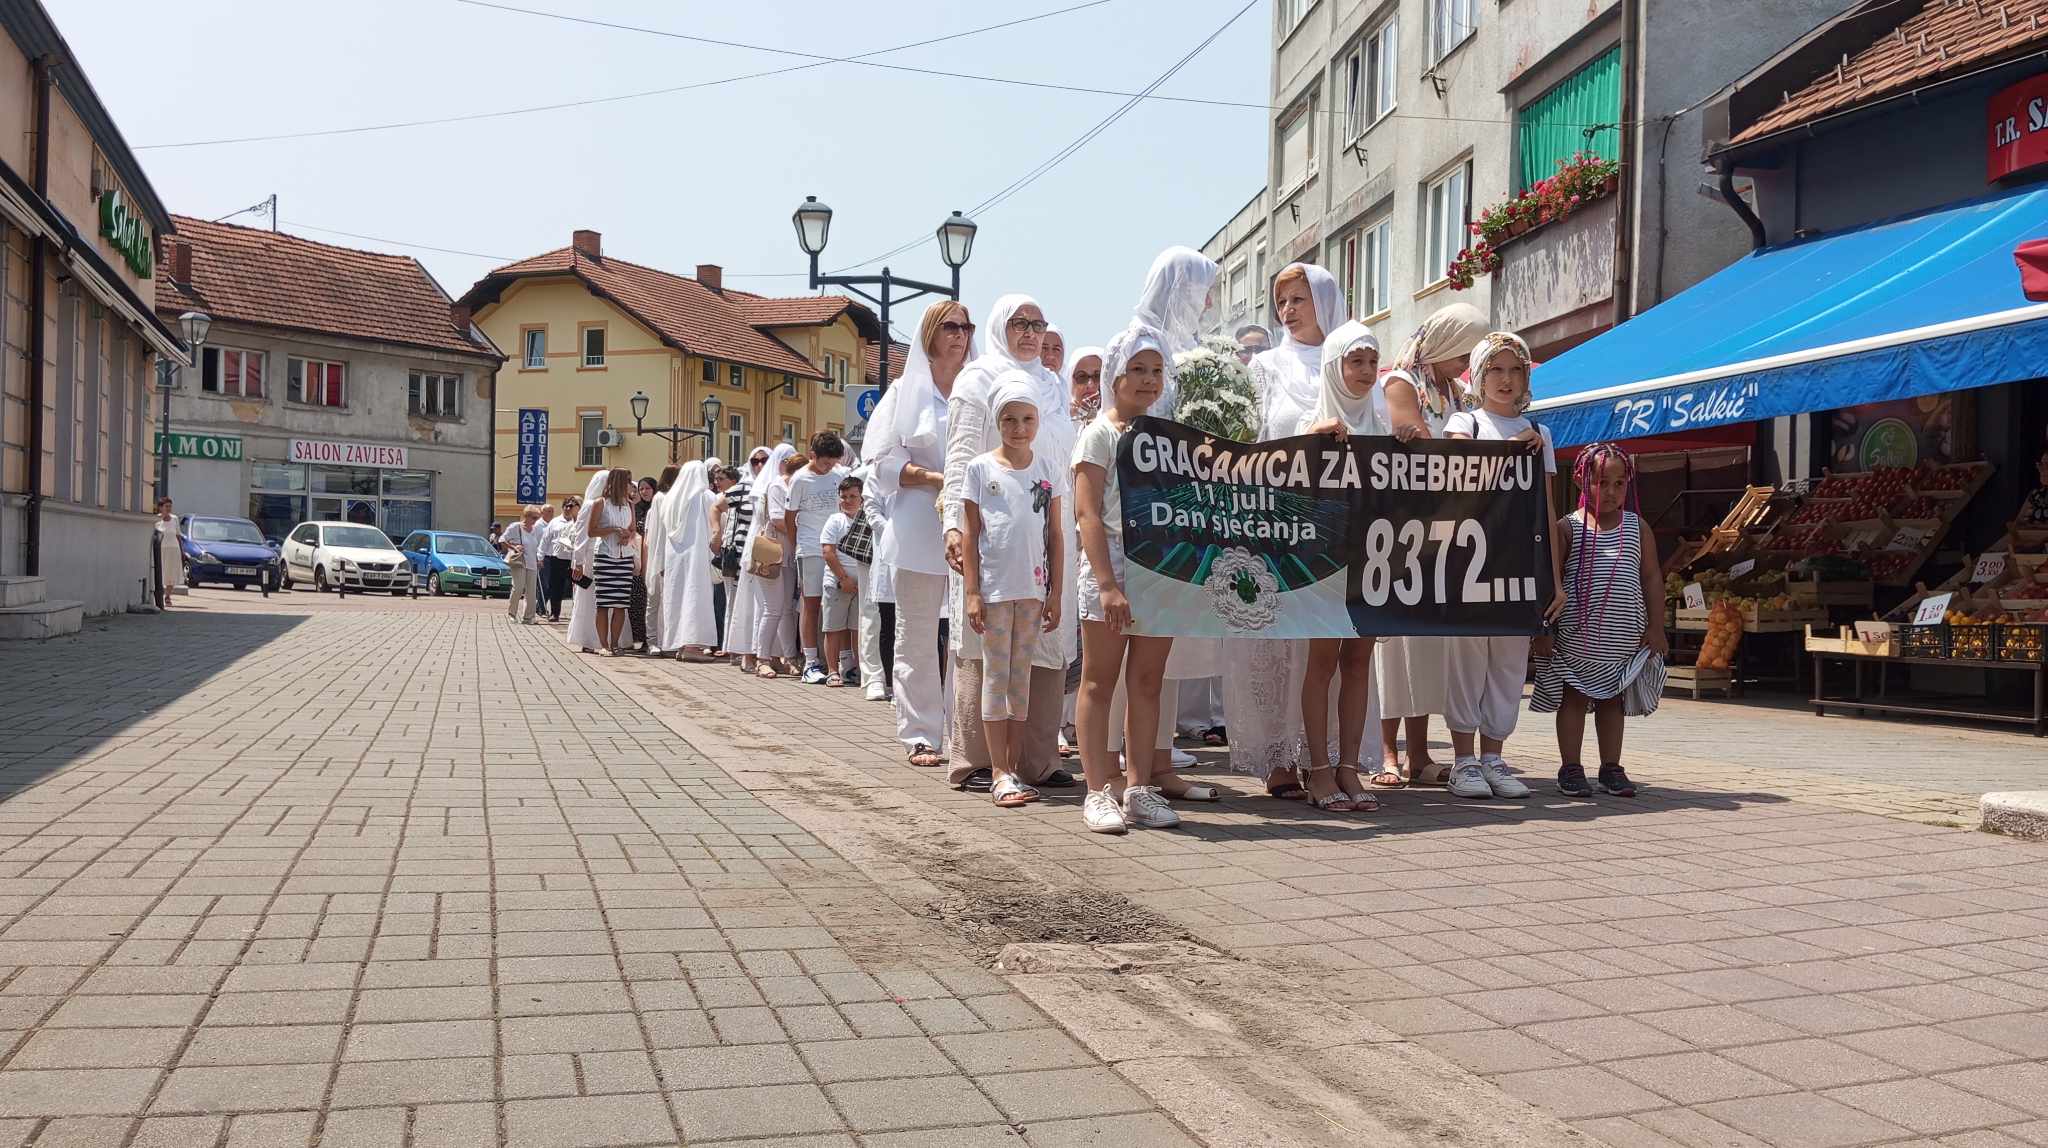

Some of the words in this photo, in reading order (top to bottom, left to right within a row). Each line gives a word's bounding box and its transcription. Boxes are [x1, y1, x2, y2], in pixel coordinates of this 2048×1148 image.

[1995, 117, 2021, 148] T.R.
[1615, 399, 1654, 433] TR
[1663, 383, 1759, 427] "Salkić"
[295, 441, 341, 462] SALON
[346, 445, 404, 466] ZAVJESA
[520, 412, 535, 486] APOTEKA
[536, 412, 547, 487] APOTEKA
[1132, 432, 1311, 488] GRAČANICA
[1319, 450, 1362, 489] ZA
[1370, 452, 1533, 492] SREBRENICU
[1191, 481, 1225, 507] 11.
[1231, 485, 1275, 515] juli
[1151, 502, 1206, 529] Dan
[1212, 511, 1317, 546] sjećanja
[1361, 518, 1537, 607] 8372...
